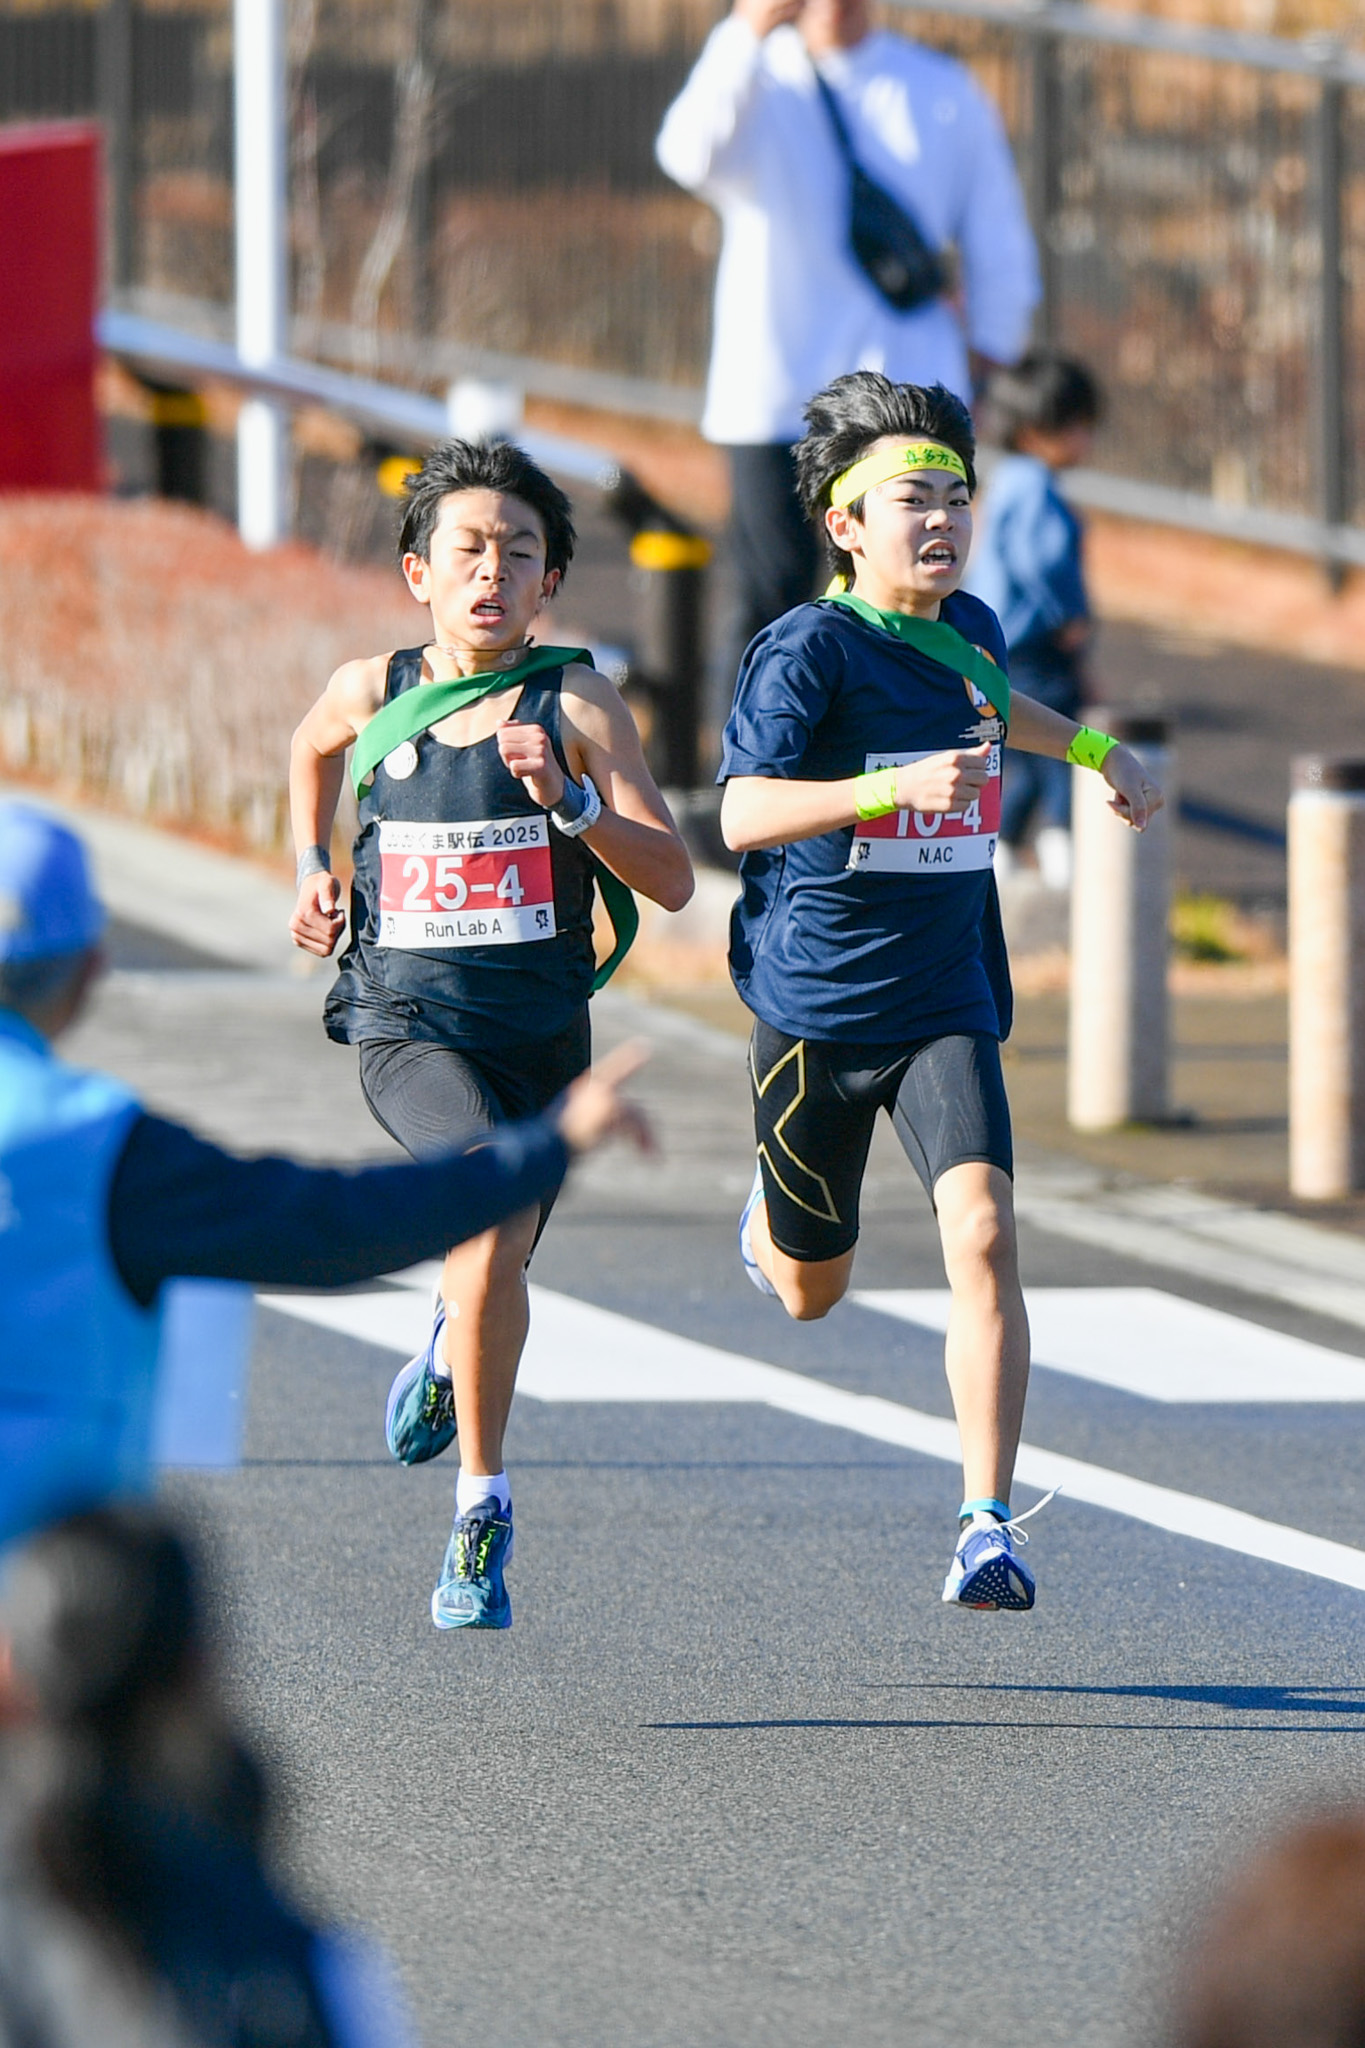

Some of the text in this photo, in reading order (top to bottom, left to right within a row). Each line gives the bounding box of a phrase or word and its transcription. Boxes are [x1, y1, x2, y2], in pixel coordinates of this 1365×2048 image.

[492, 824, 540, 846] 2025
[918, 846, 953, 864] N.AC
[402, 856, 525, 911] 25-4
[425, 920, 503, 937] Run Lab A
